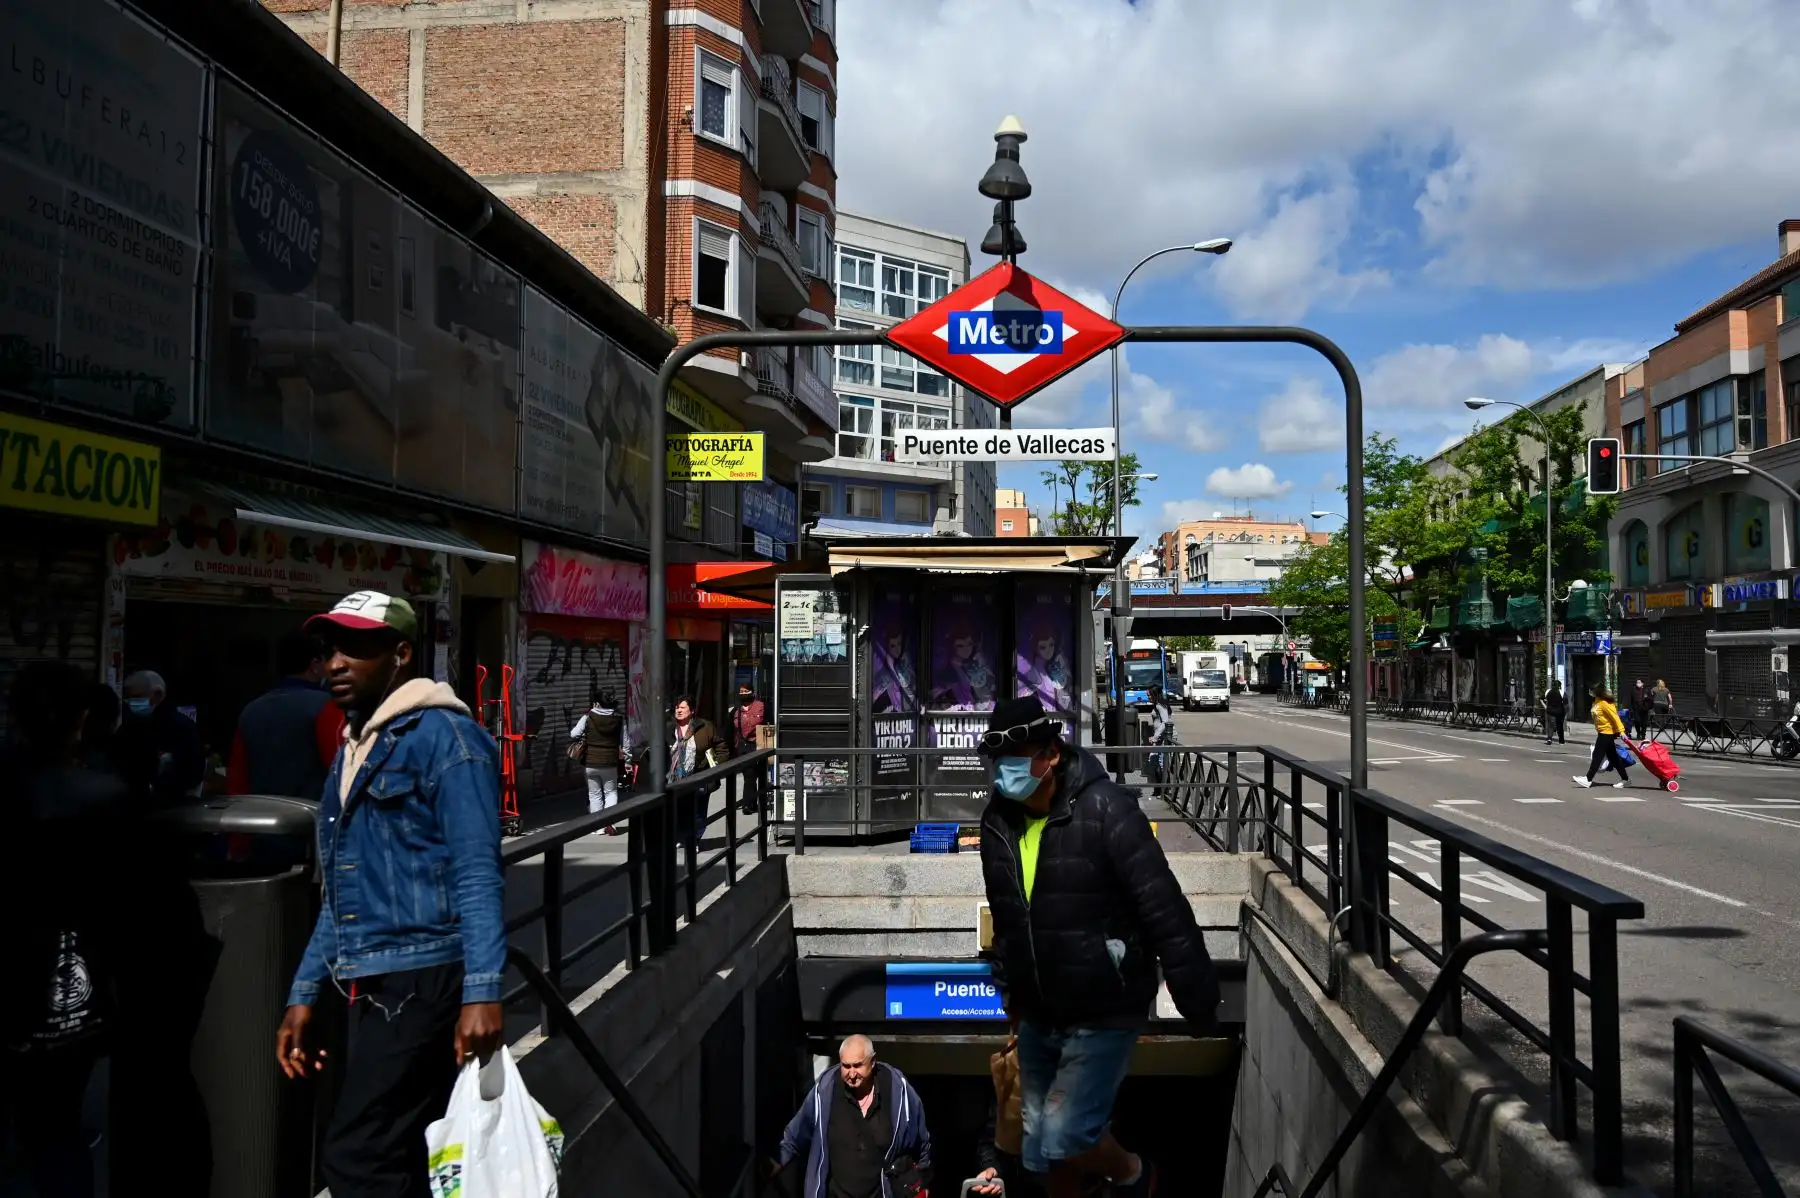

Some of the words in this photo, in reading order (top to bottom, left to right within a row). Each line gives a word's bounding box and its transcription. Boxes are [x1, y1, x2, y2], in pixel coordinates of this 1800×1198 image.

[41, 129, 186, 231] VIVIENDAS
[240, 161, 320, 264] 158.000€
[27, 194, 39, 213] 2
[42, 201, 118, 249] CUARTOS
[122, 238, 141, 259] DE
[71, 191, 80, 209] 2
[84, 196, 185, 257] DORMITORIOS
[959, 317, 1054, 345] Metro
[666, 436, 754, 452] FOTOGRAFÍA
[904, 435, 978, 455] Puente
[984, 434, 1011, 455] de
[1017, 434, 1105, 455] Vallecas
[674, 454, 710, 469] Miguel
[194, 561, 206, 573] EL
[206, 562, 236, 576] PRECIO
[783, 601, 791, 609] 2
[934, 981, 996, 998] Puente
[940, 1007, 994, 1015] Acceso/Access
